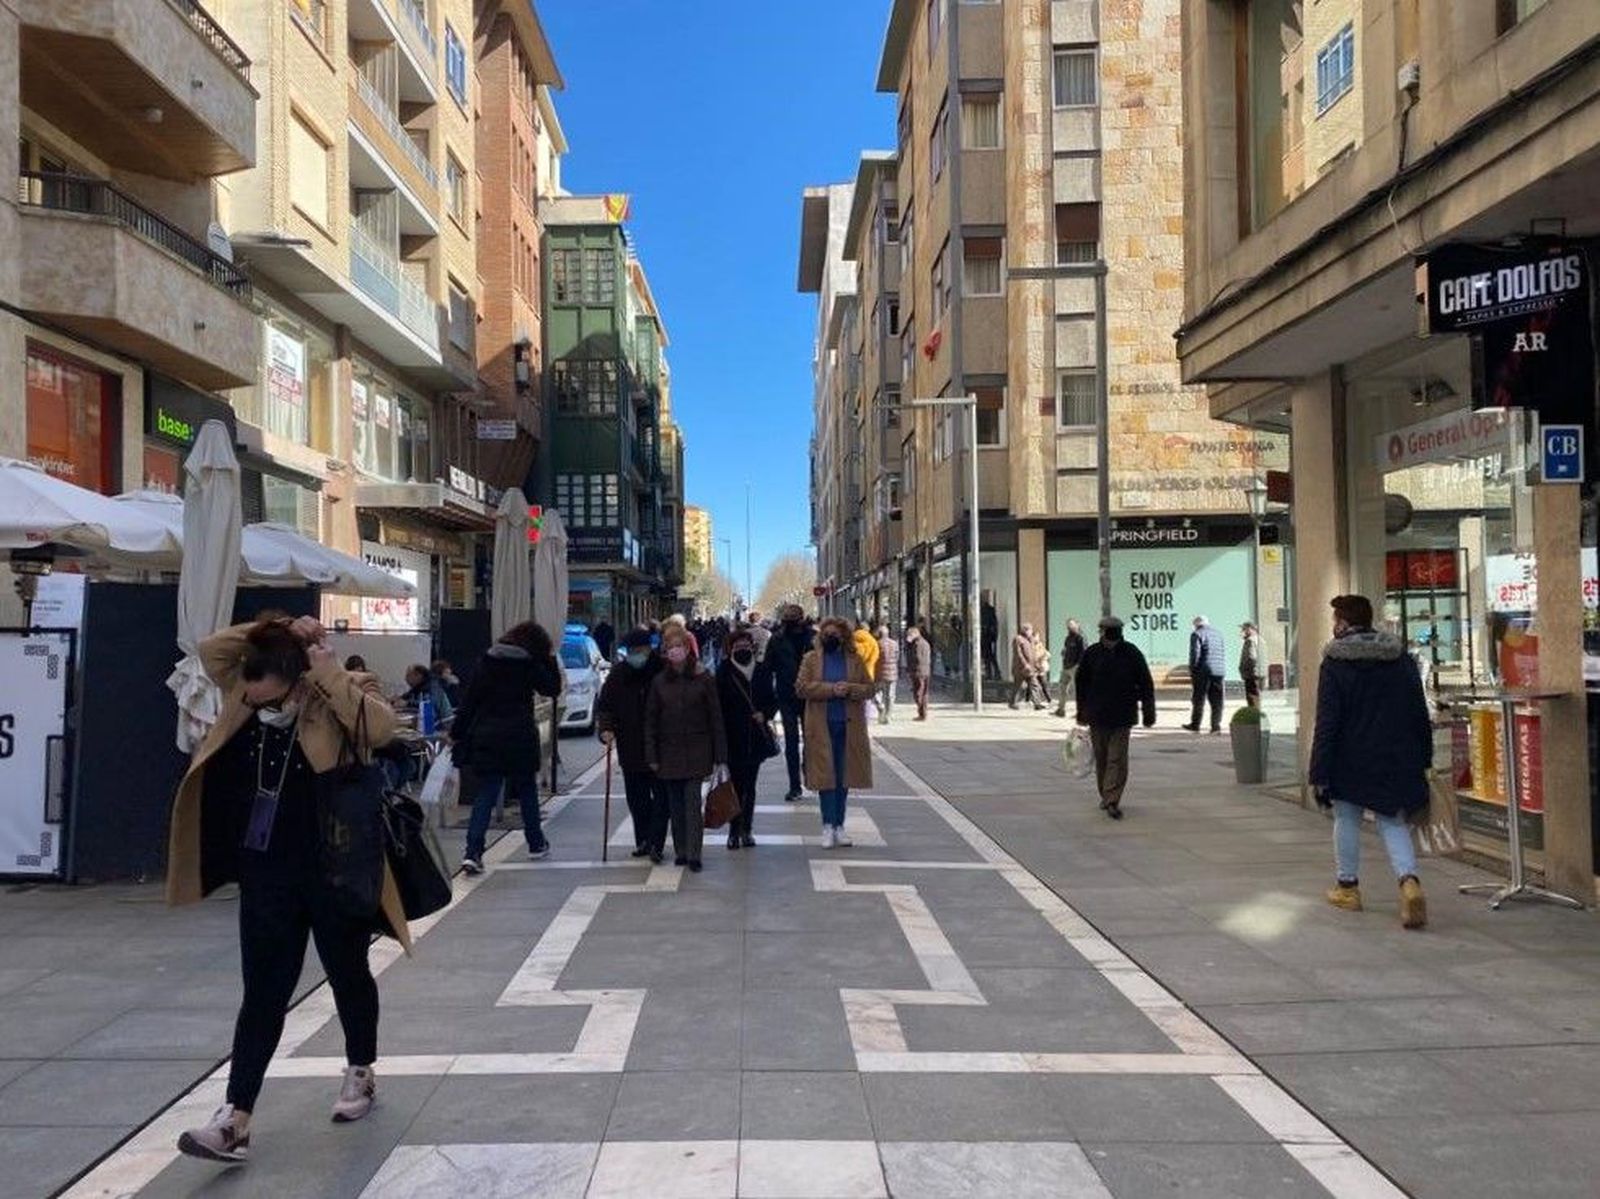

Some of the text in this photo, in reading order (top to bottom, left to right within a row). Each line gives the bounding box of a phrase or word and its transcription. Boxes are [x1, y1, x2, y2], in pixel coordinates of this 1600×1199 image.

[1497, 254, 1582, 303] DOLFOS
[1407, 416, 1466, 454] General
[1547, 435, 1578, 457] CB
[1130, 571, 1177, 590] ENJOY
[1134, 592, 1174, 610] YOUR
[1130, 613, 1179, 631] STORE
